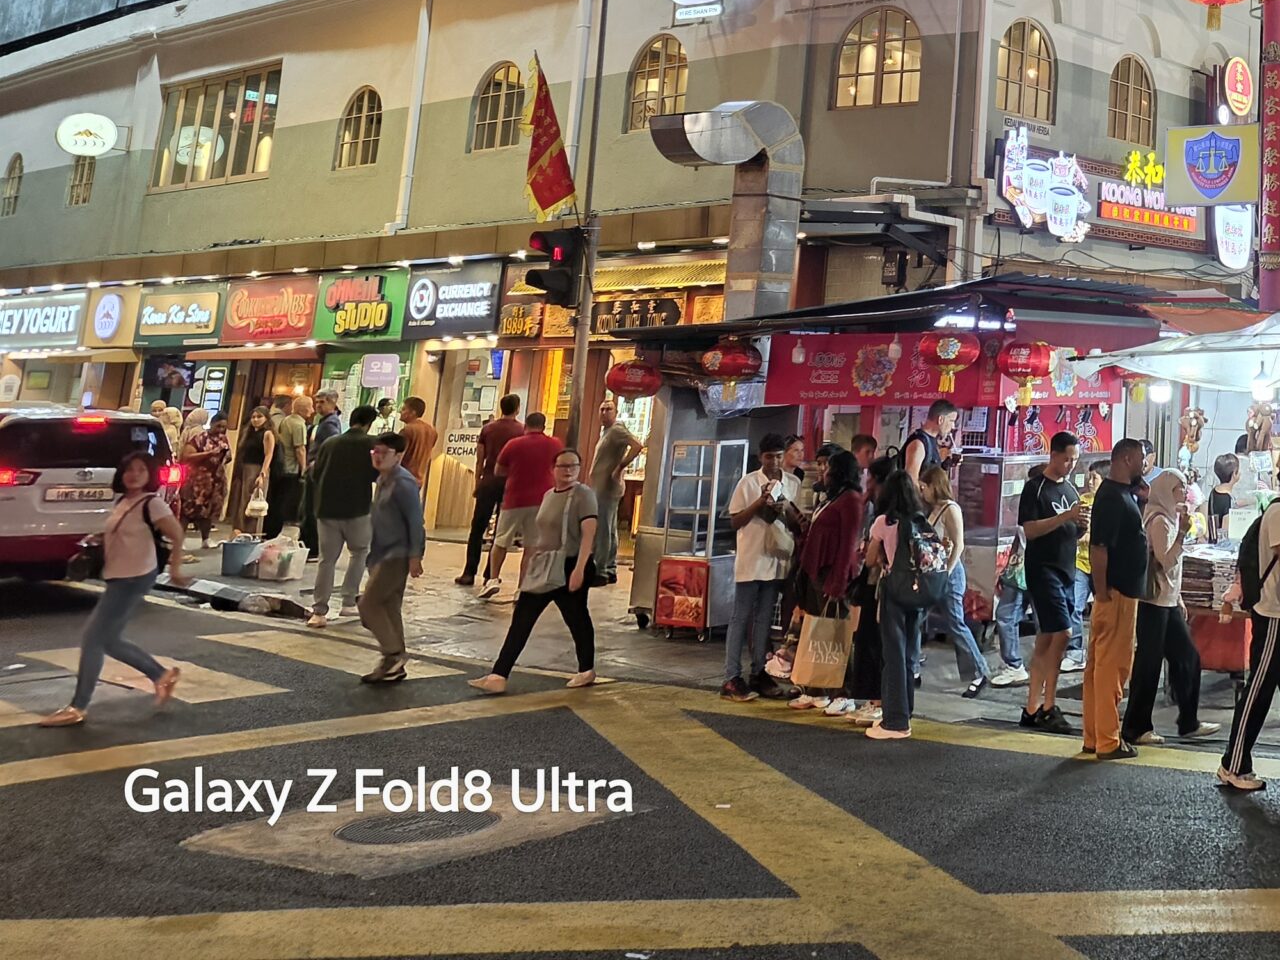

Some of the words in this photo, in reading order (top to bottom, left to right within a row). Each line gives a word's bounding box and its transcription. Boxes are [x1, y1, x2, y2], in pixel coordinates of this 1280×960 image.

[1036, 124, 1050, 136] HERBA
[1124, 150, 1166, 190] 恭和
[1101, 182, 1142, 206] KOONG
[438, 282, 491, 300] CURRENCY
[21, 304, 80, 334] YOGURT
[334, 301, 388, 333] STUDIO
[435, 300, 491, 319] EXCHANGE
[78, 489, 104, 500] 8449
